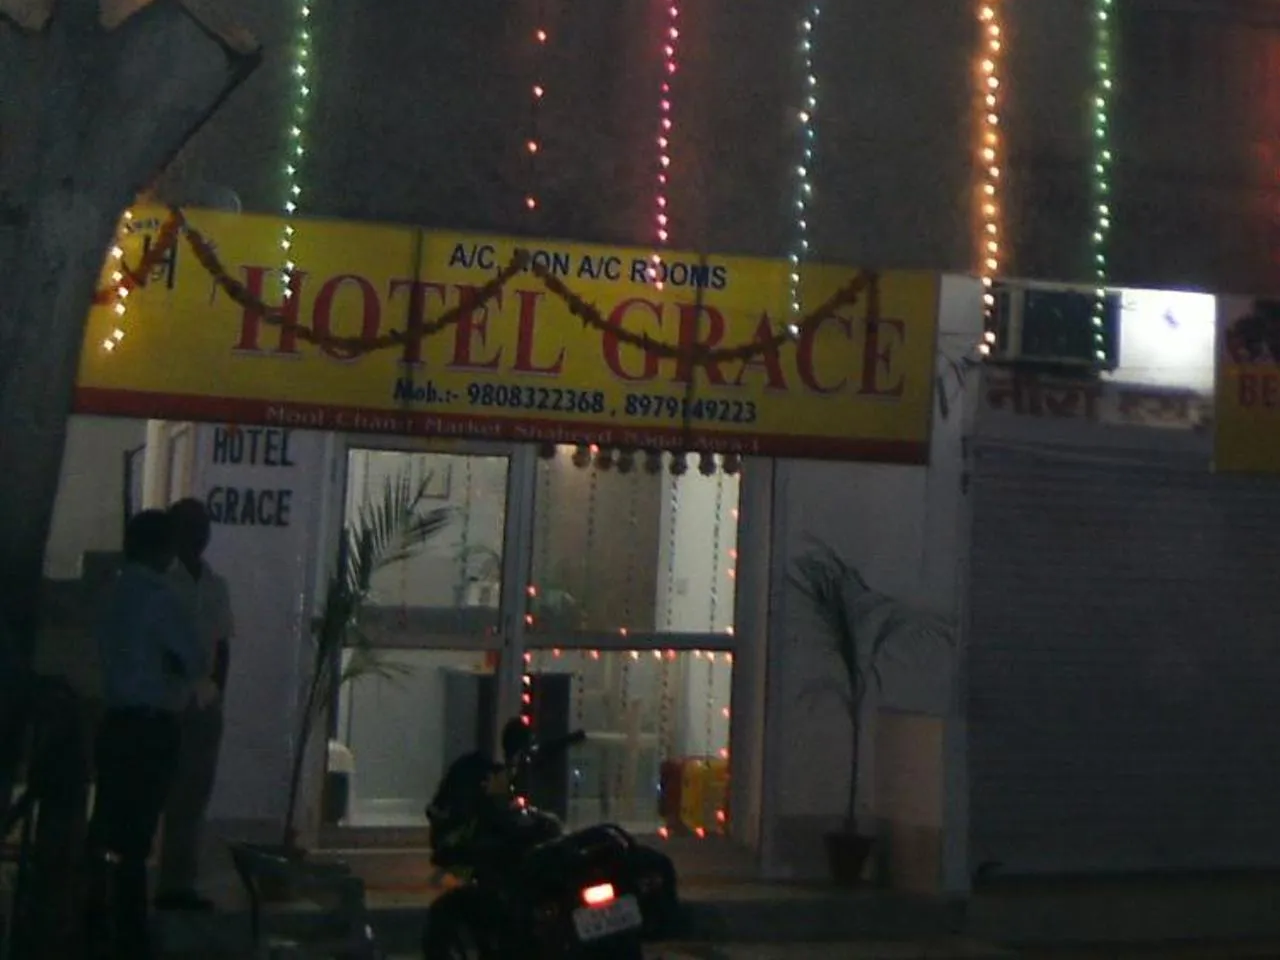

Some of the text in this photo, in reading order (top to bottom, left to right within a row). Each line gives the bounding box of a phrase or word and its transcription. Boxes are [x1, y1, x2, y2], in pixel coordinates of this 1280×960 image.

[577, 251, 621, 279] A/C
[232, 264, 906, 397] HOTEL GRACE
[213, 427, 293, 466] HOTEL
[206, 488, 291, 526] GRACE
